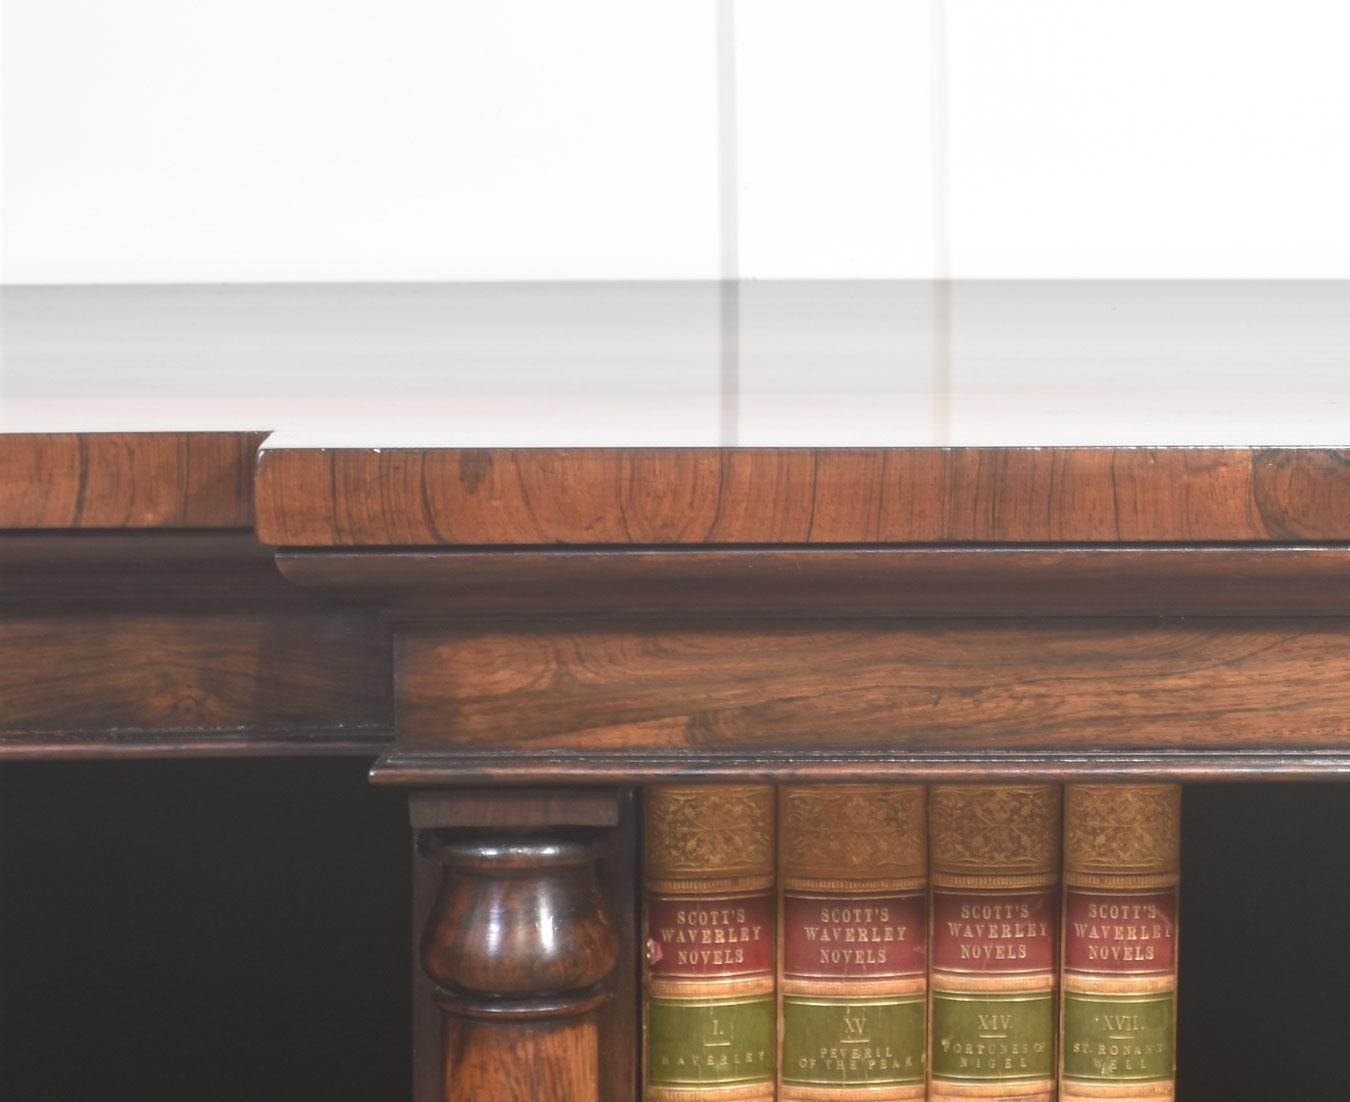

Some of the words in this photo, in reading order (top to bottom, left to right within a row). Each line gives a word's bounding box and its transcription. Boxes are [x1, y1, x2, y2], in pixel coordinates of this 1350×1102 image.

[677, 908, 746, 926] SCOTT'S
[821, 908, 890, 923] SCOTT'S
[961, 905, 1029, 920] SCOTT'S
[1088, 903, 1157, 919] SCOTT'S
[661, 926, 762, 944] WAVERLEY
[804, 926, 907, 942] WAVERLEY
[948, 922, 1048, 938] WAVERLEY
[1073, 922, 1171, 940] WAVERLEY
[678, 949, 744, 965] NOVELS
[820, 949, 887, 964] NOVELS
[960, 944, 1027, 959] NOVELS
[1088, 945, 1154, 961] NOVELS
[820, 1047, 893, 1060] PEVERIL
[943, 1041, 1028, 1055] FORTUNES
[661, 1051, 766, 1066] WAVERLEY
[799, 1058, 817, 1069] OF
[826, 1060, 857, 1070] THE
[868, 1056, 913, 1070] PEAK
[960, 1057, 1027, 1069] NIGEL
[1093, 1058, 1147, 1070] WELL
